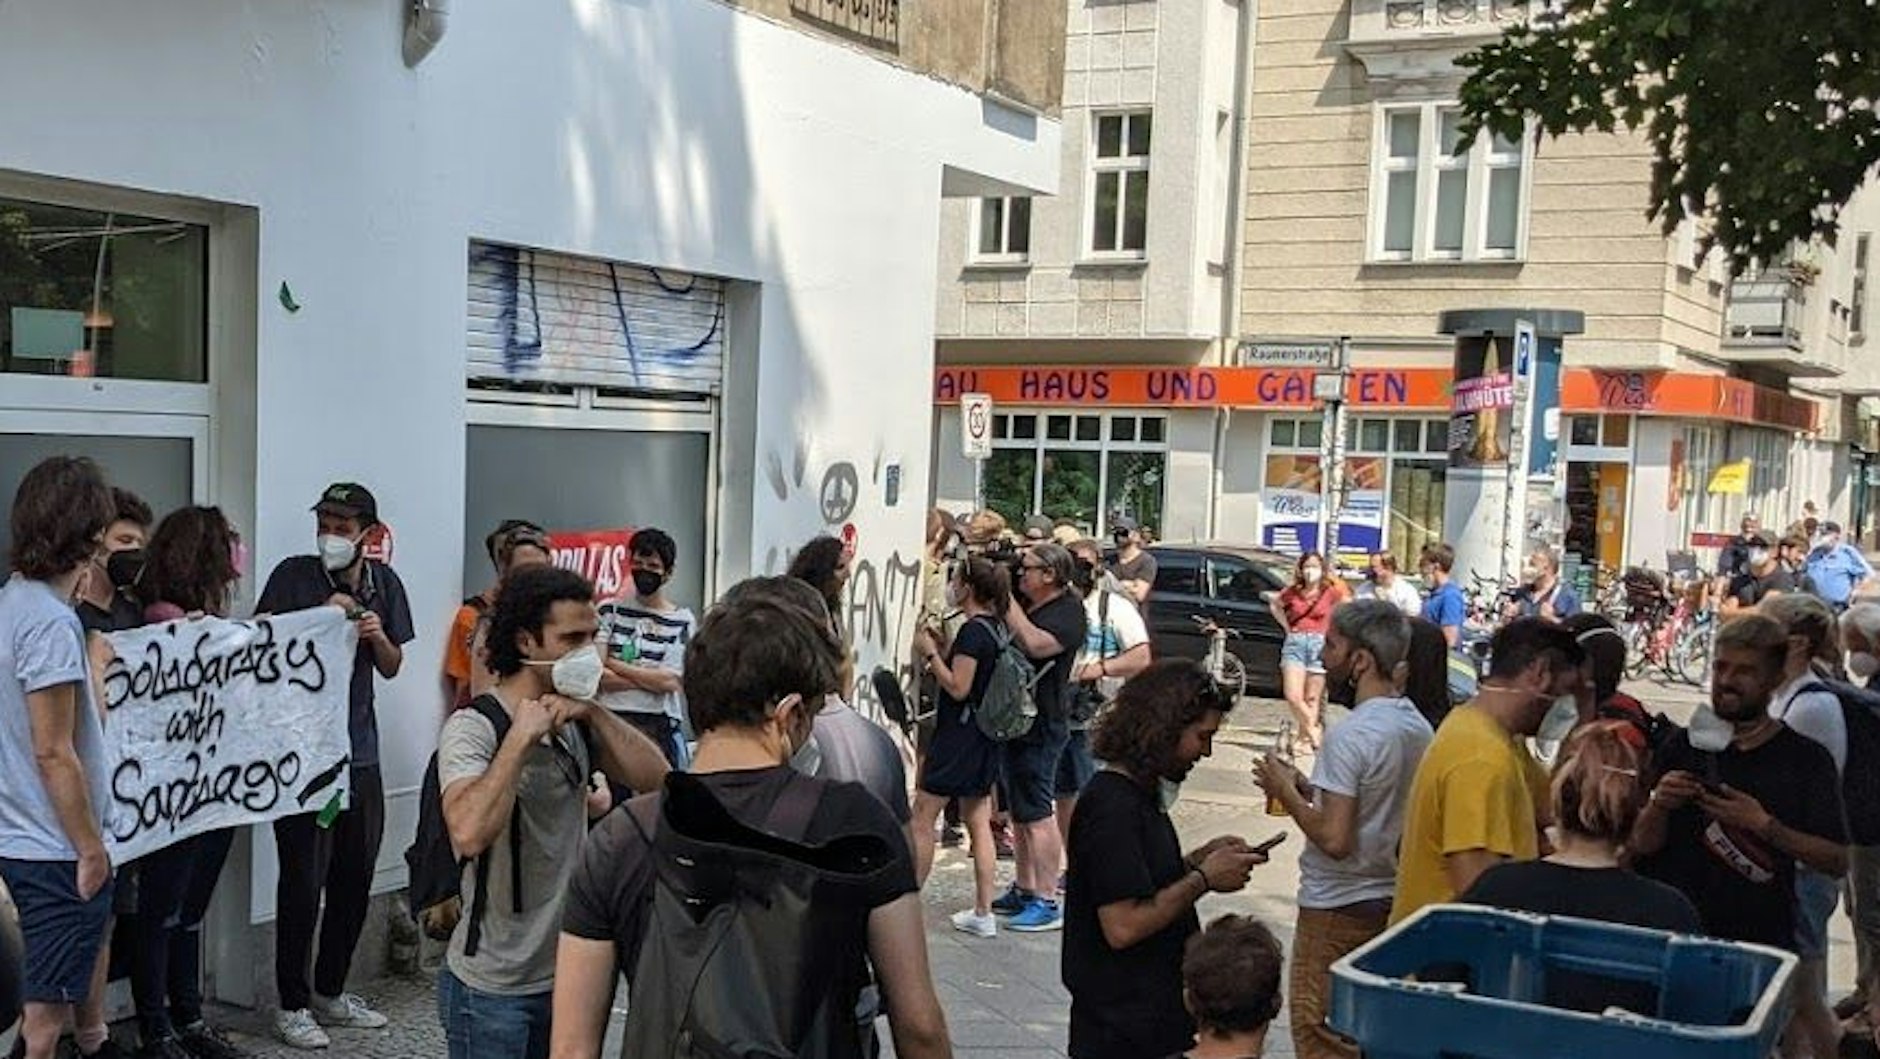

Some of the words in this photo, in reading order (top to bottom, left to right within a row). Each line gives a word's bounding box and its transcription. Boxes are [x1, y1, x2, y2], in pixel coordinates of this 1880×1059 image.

[1250, 346, 1329, 363] Raumerstraße
[1021, 371, 1110, 400] HAUS
[1146, 371, 1217, 401] UND
[1257, 371, 1407, 403] GAEN
[166, 692, 225, 744] with
[112, 745, 301, 843] Santiago
